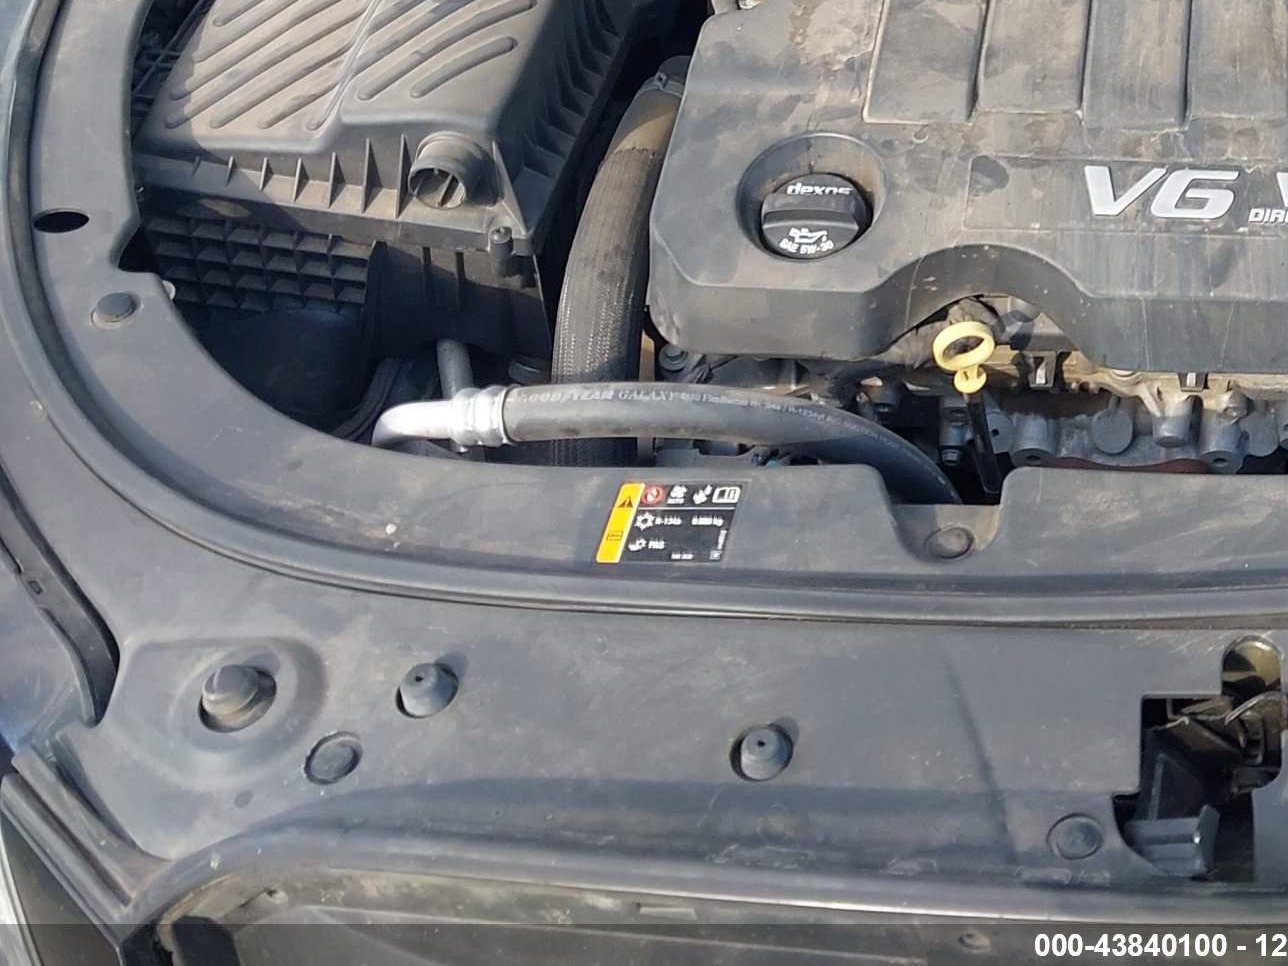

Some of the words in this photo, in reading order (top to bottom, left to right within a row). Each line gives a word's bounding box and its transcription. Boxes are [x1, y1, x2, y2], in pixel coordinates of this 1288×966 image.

[1084, 165, 1240, 219] V6
[778, 237, 800, 253] SAE
[800, 239, 835, 255] 5W-30
